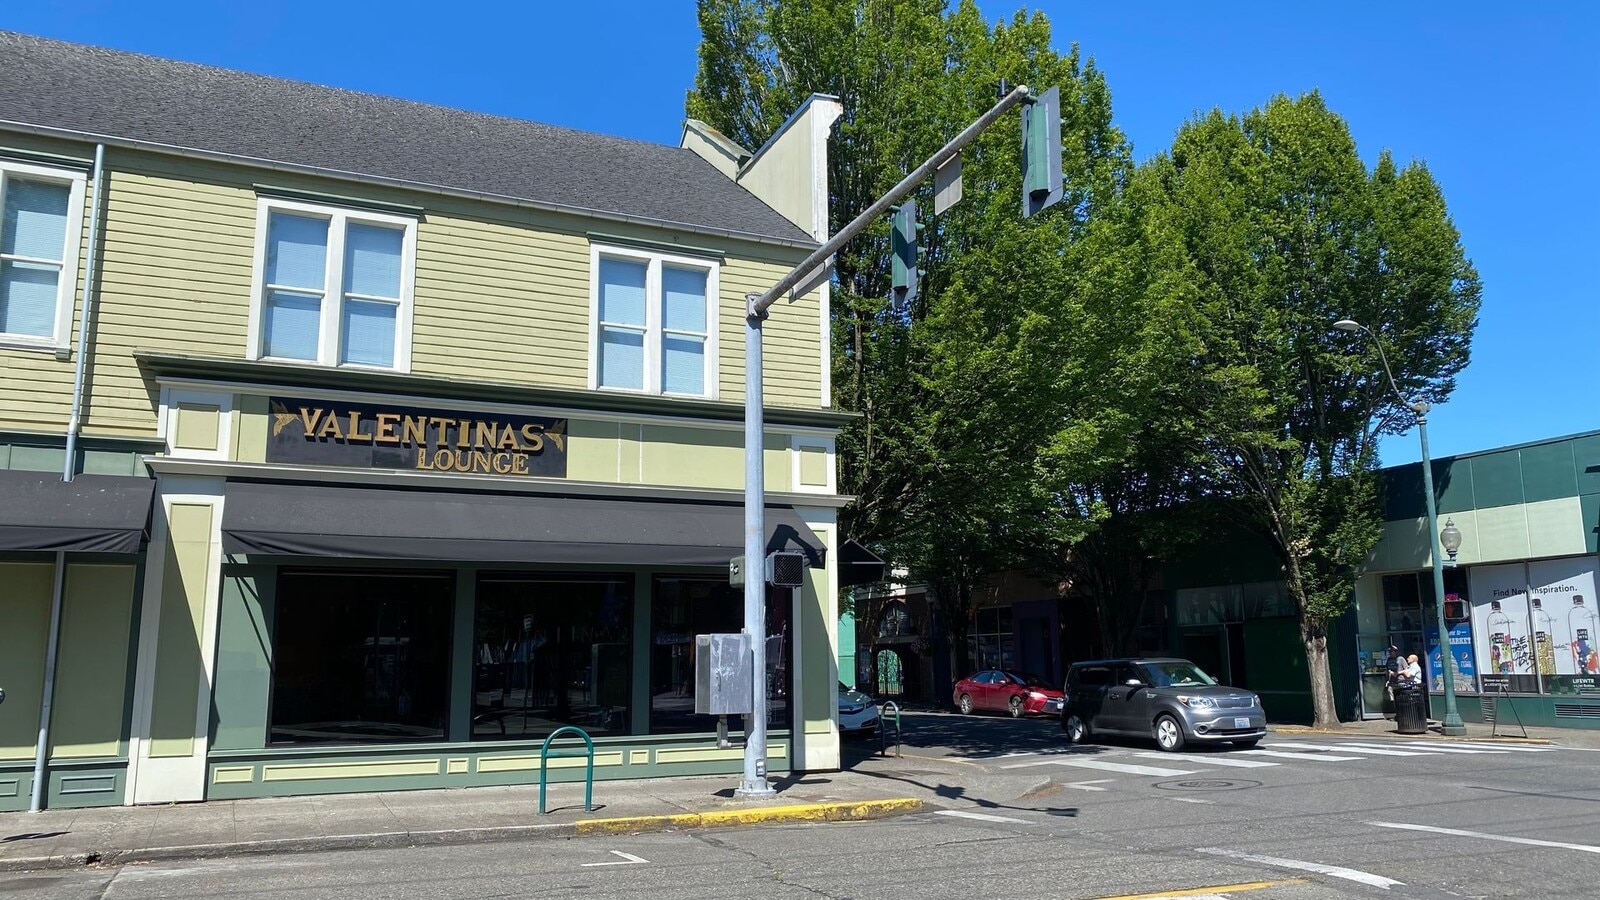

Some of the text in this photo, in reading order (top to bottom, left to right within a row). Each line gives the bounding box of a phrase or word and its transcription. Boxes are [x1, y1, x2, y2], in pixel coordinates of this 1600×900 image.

[299, 406, 544, 451] VALENTINAS
[416, 447, 529, 475] LOUNGE
[1493, 589, 1509, 597] Find
[1532, 585, 1578, 595] Inspiration.
